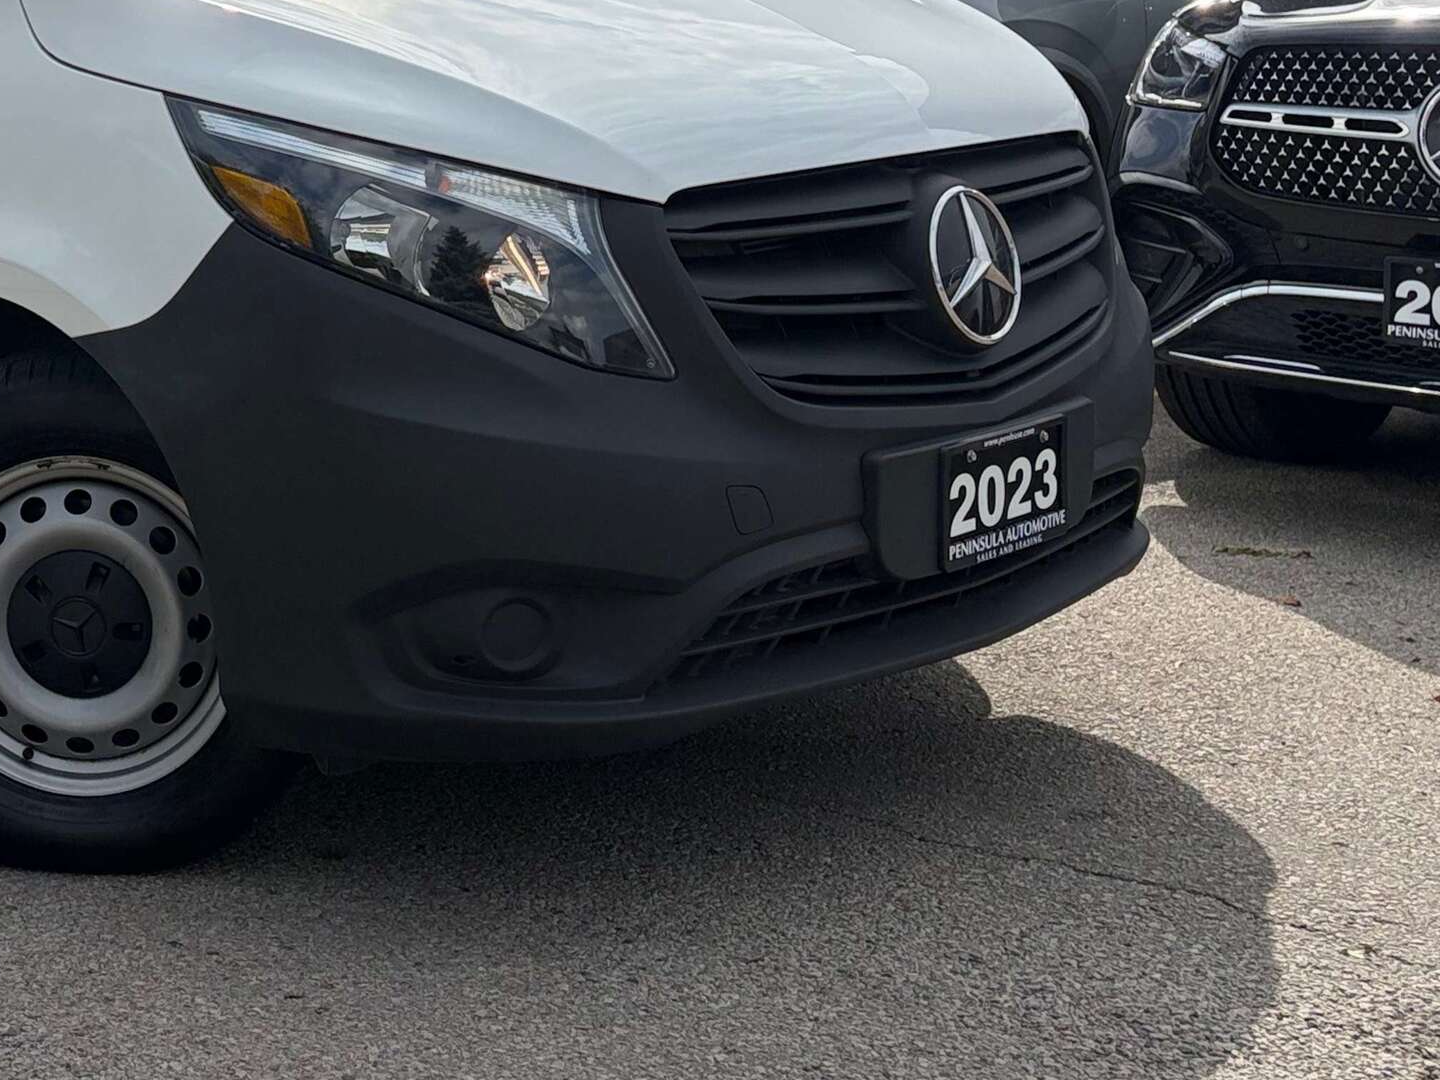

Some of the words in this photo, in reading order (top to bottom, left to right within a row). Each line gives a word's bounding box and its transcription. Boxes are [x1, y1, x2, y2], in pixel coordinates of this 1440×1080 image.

[1394, 279, 1440, 326] 2
[949, 448, 1058, 538] 2023
[1006, 509, 1066, 543] AUTOMOTIVE
[949, 530, 1005, 561] PENINSULA
[976, 550, 997, 564] SALES
[999, 543, 1014, 556] AND
[1015, 534, 1043, 551] LEASING
